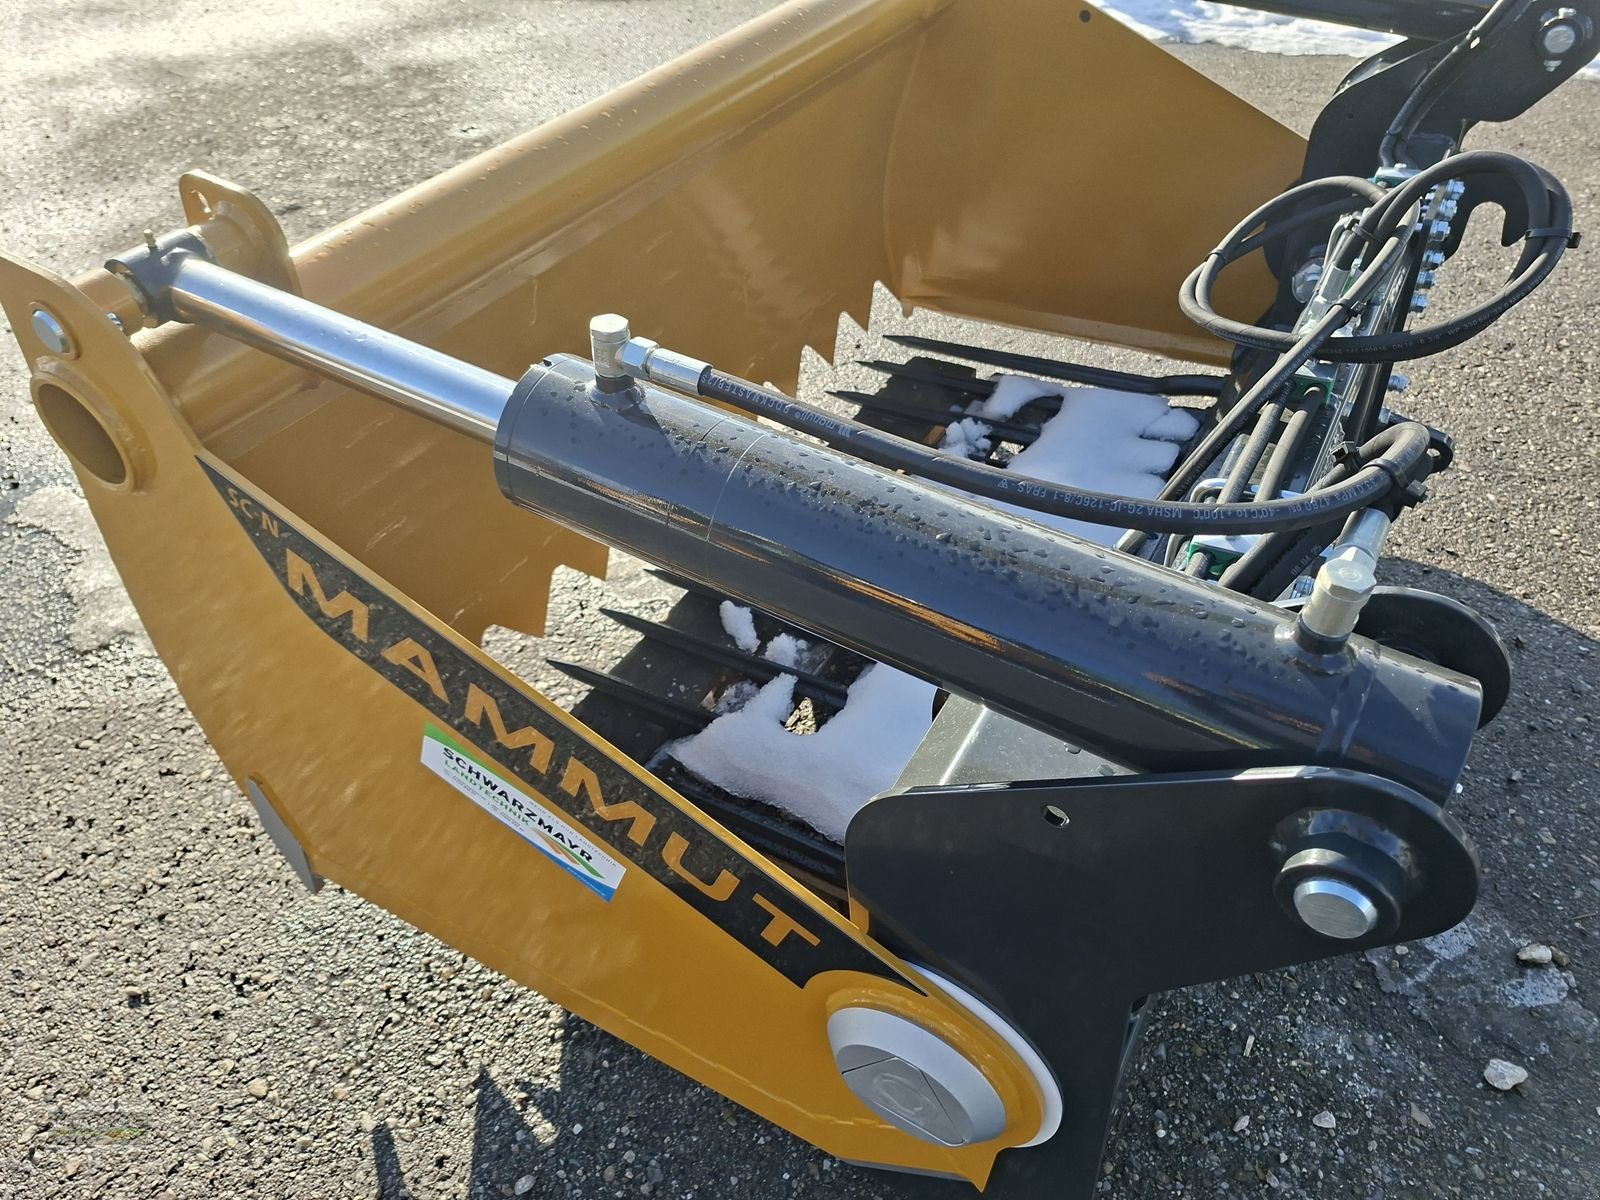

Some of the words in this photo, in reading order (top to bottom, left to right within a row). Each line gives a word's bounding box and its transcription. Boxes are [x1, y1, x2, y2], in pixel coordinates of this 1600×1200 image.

[1147, 506, 1182, 519] MSHA
[286, 548, 821, 947] MAMMUT
[443, 747, 593, 862] SCHWARZMAYR
[445, 760, 530, 826] LANDTECHNIK
